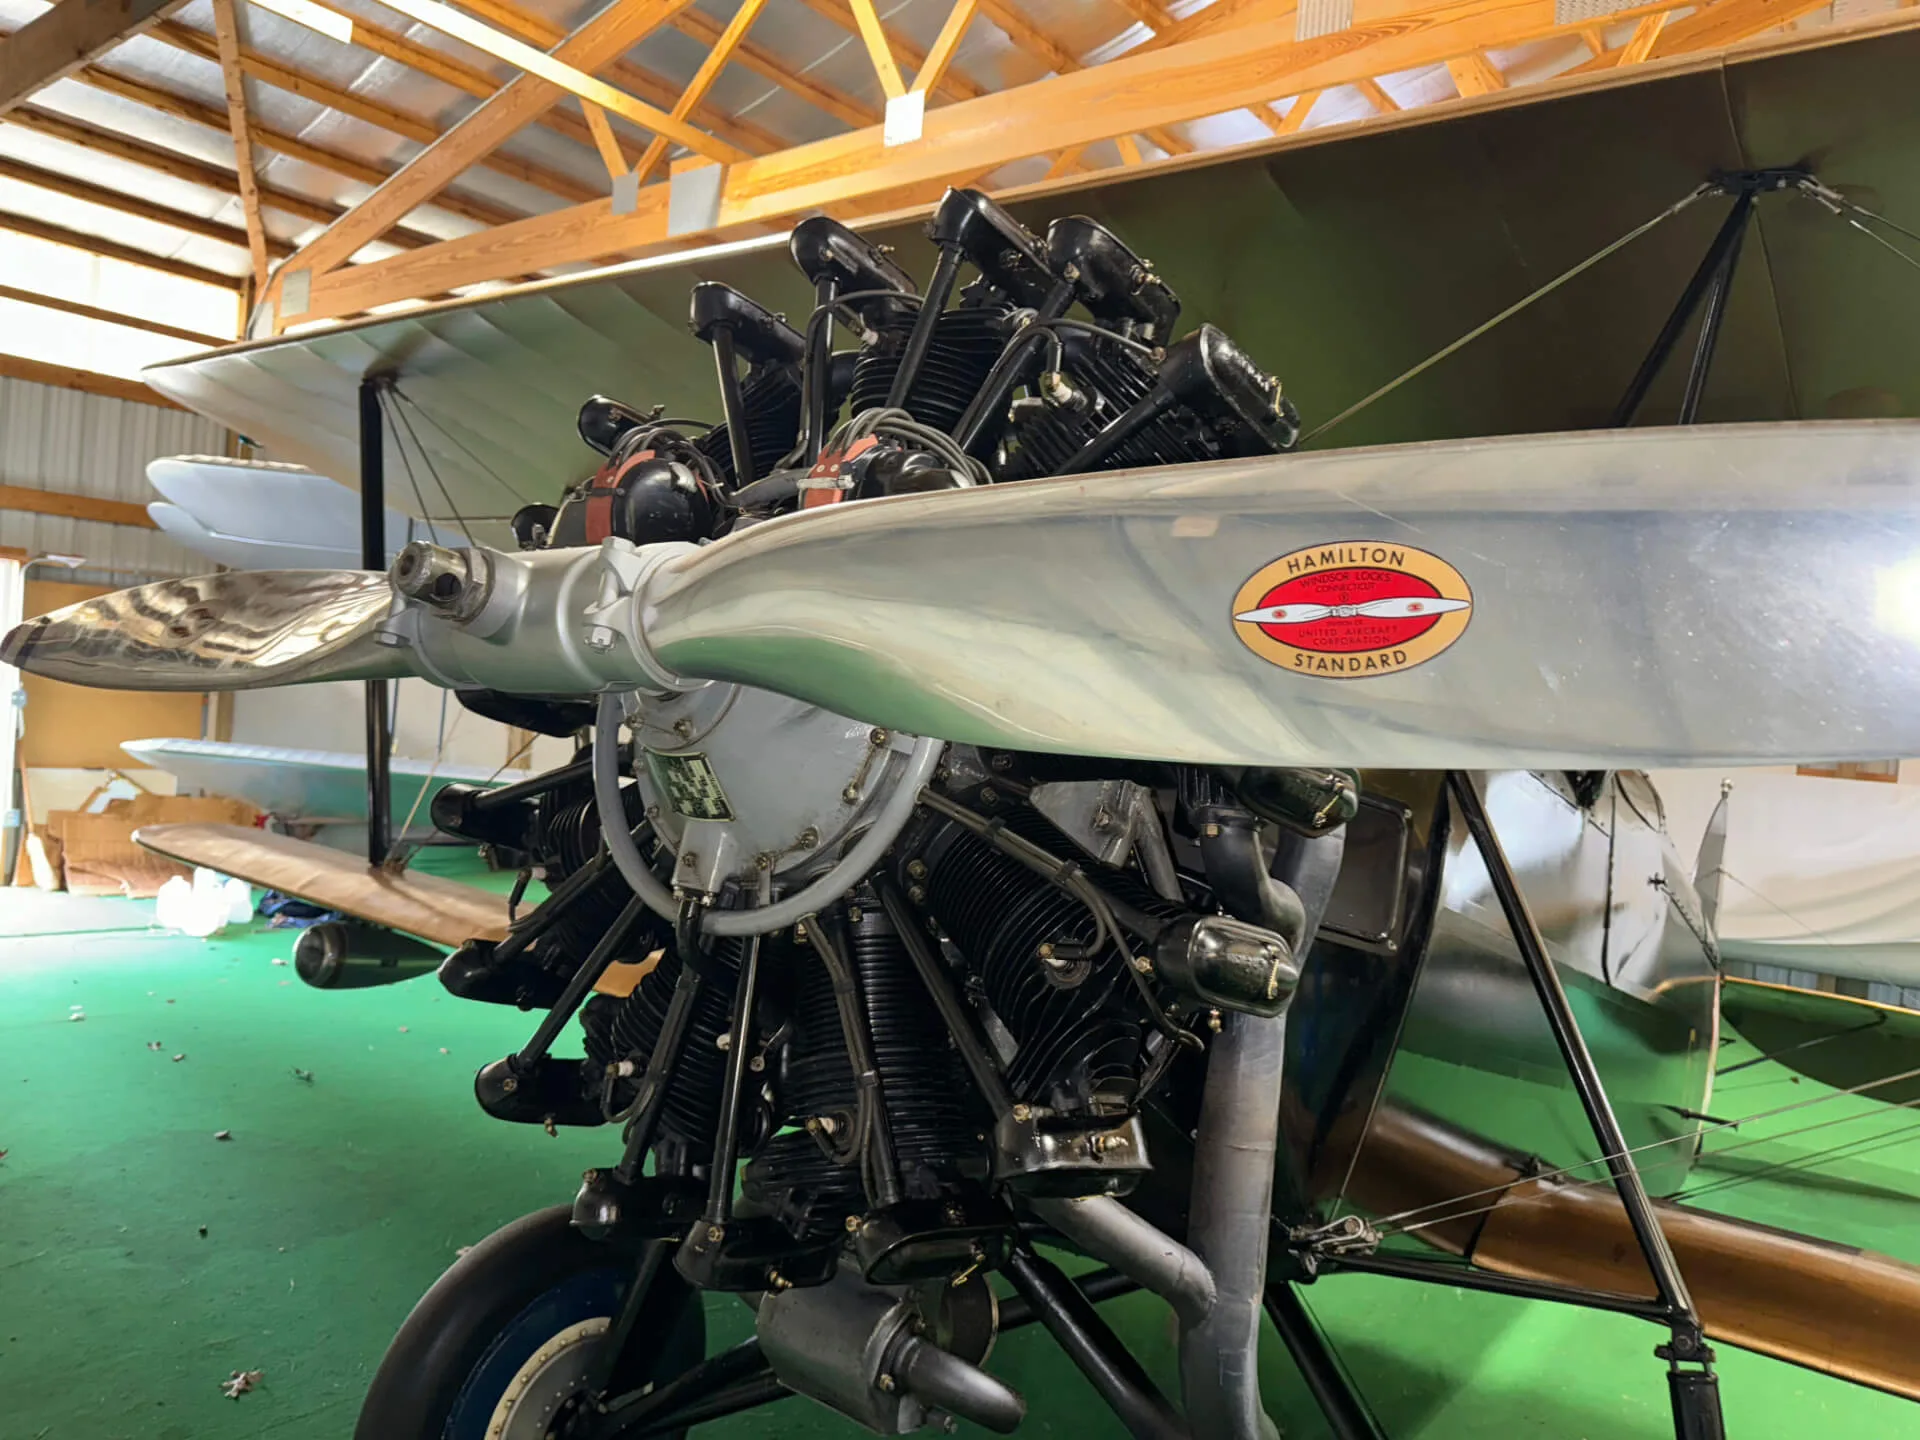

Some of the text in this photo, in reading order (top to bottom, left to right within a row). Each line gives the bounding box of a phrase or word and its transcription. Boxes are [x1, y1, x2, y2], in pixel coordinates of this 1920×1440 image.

[1287, 547, 1405, 574] HAMILTON
[1356, 571, 1392, 582] LOCKS
[1299, 628, 1337, 638] UNITED
[1294, 650, 1408, 672] STANDARD
